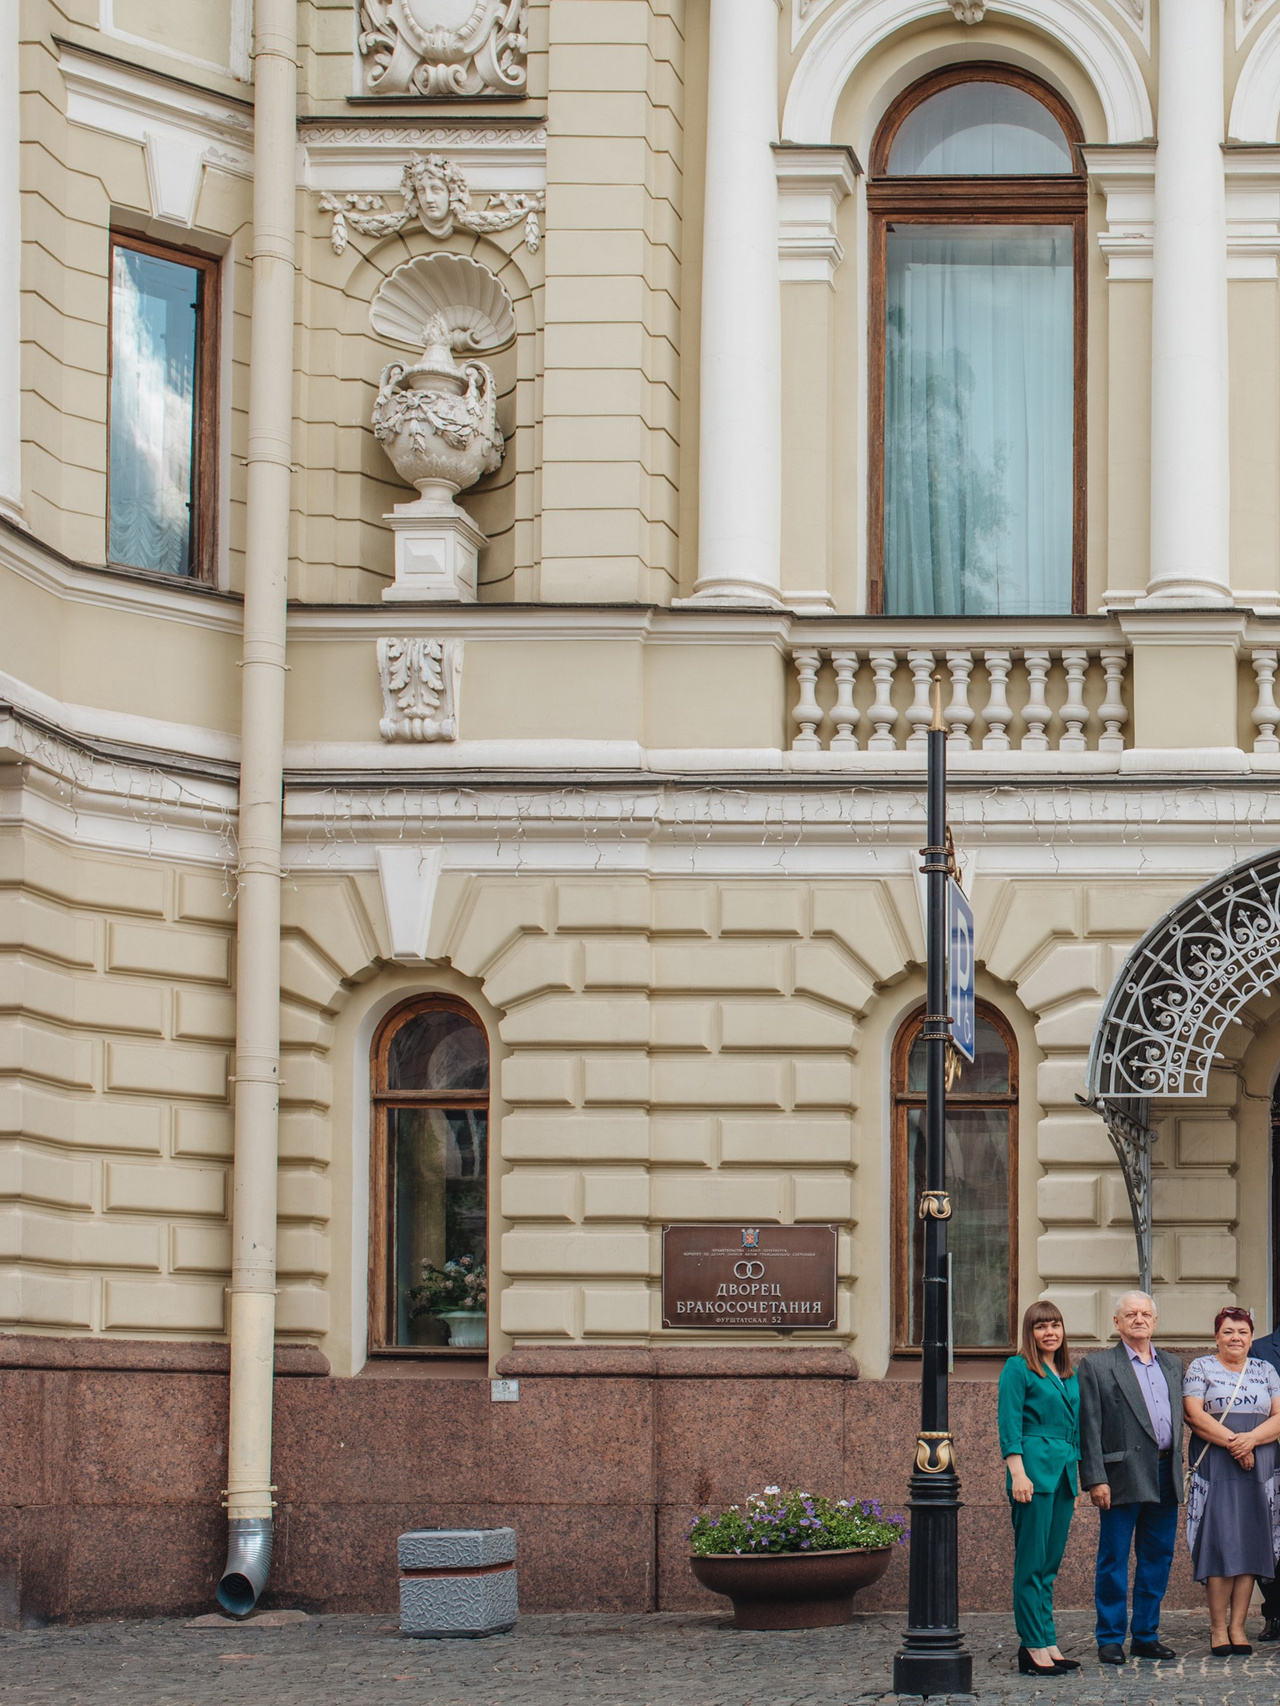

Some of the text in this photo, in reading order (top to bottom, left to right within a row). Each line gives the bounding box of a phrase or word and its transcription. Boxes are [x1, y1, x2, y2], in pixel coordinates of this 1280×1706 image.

[716, 1283, 782, 1297] ДВОРЕЦ
[676, 1301, 822, 1314] БРАКОСОЧЕТАНИЯ
[771, 1316, 782, 1324] 52
